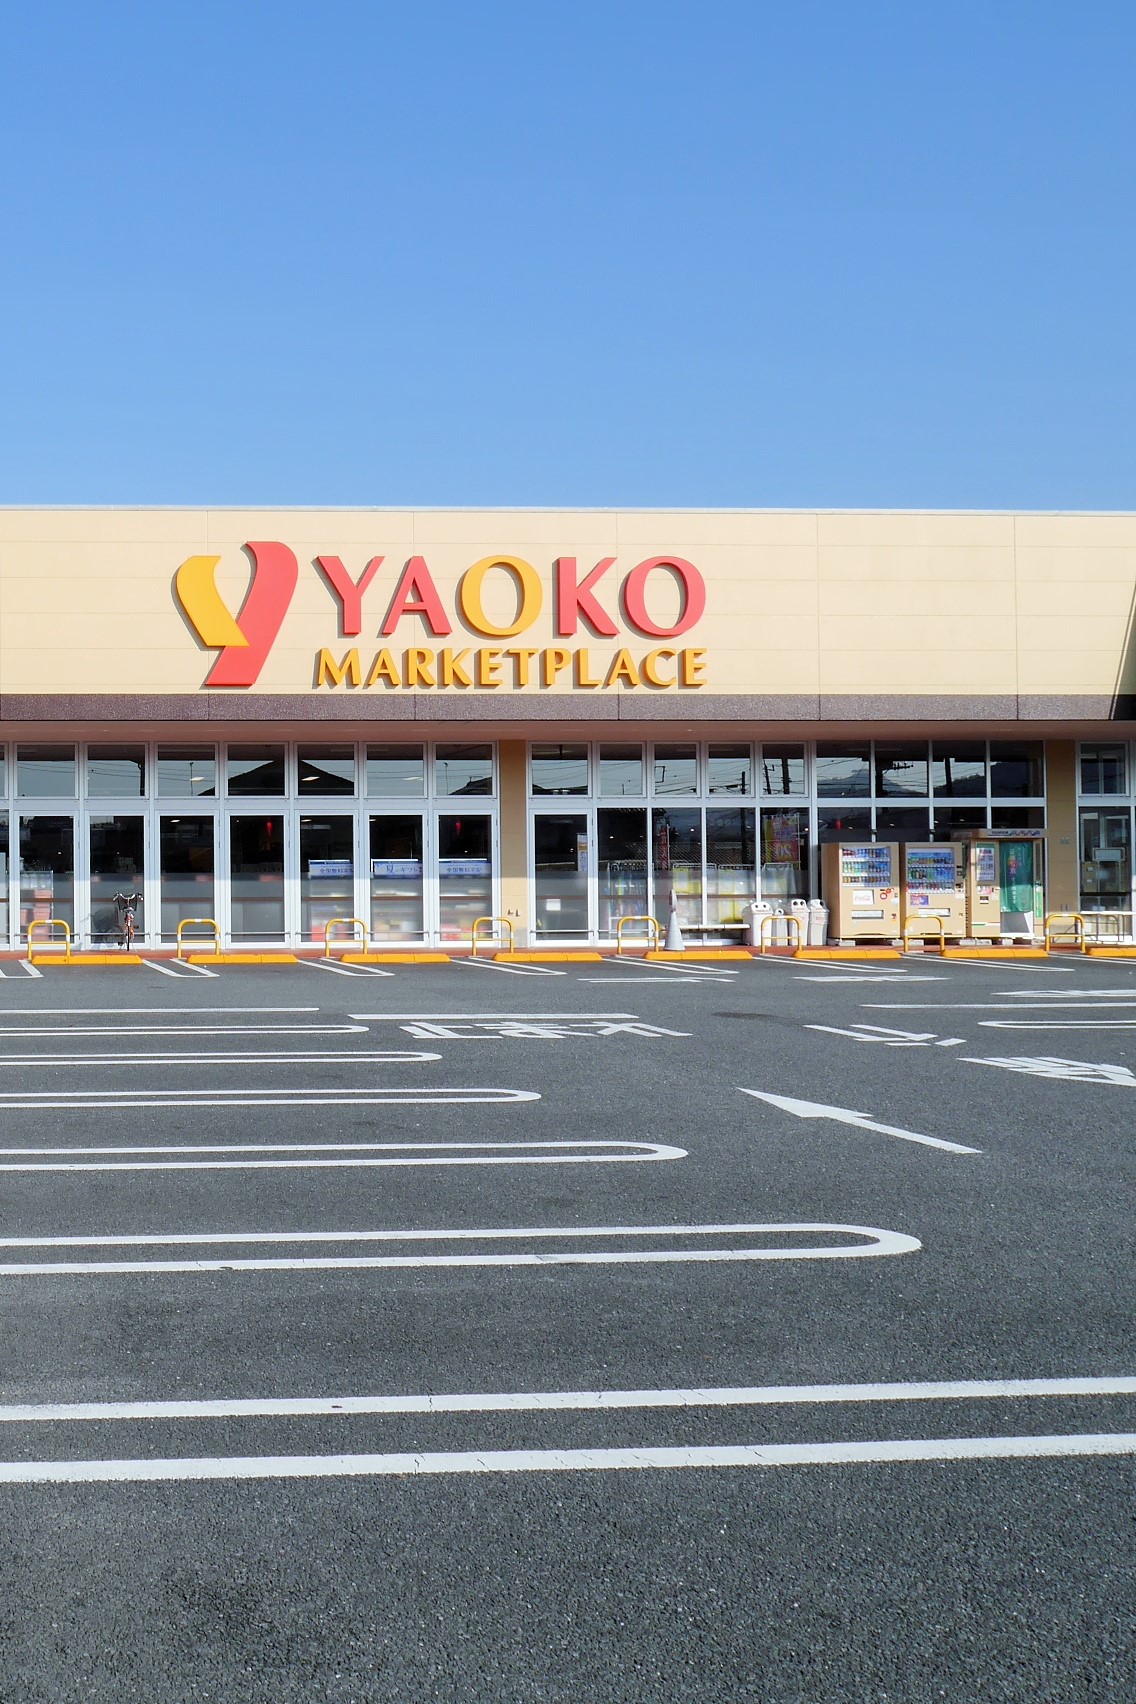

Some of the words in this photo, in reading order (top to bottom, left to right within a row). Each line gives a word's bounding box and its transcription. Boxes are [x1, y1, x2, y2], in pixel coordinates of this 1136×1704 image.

[317, 555, 706, 639] YAOKO
[317, 647, 707, 687] MARKETPLACE
[399, 1021, 693, 1039] 止まれ
